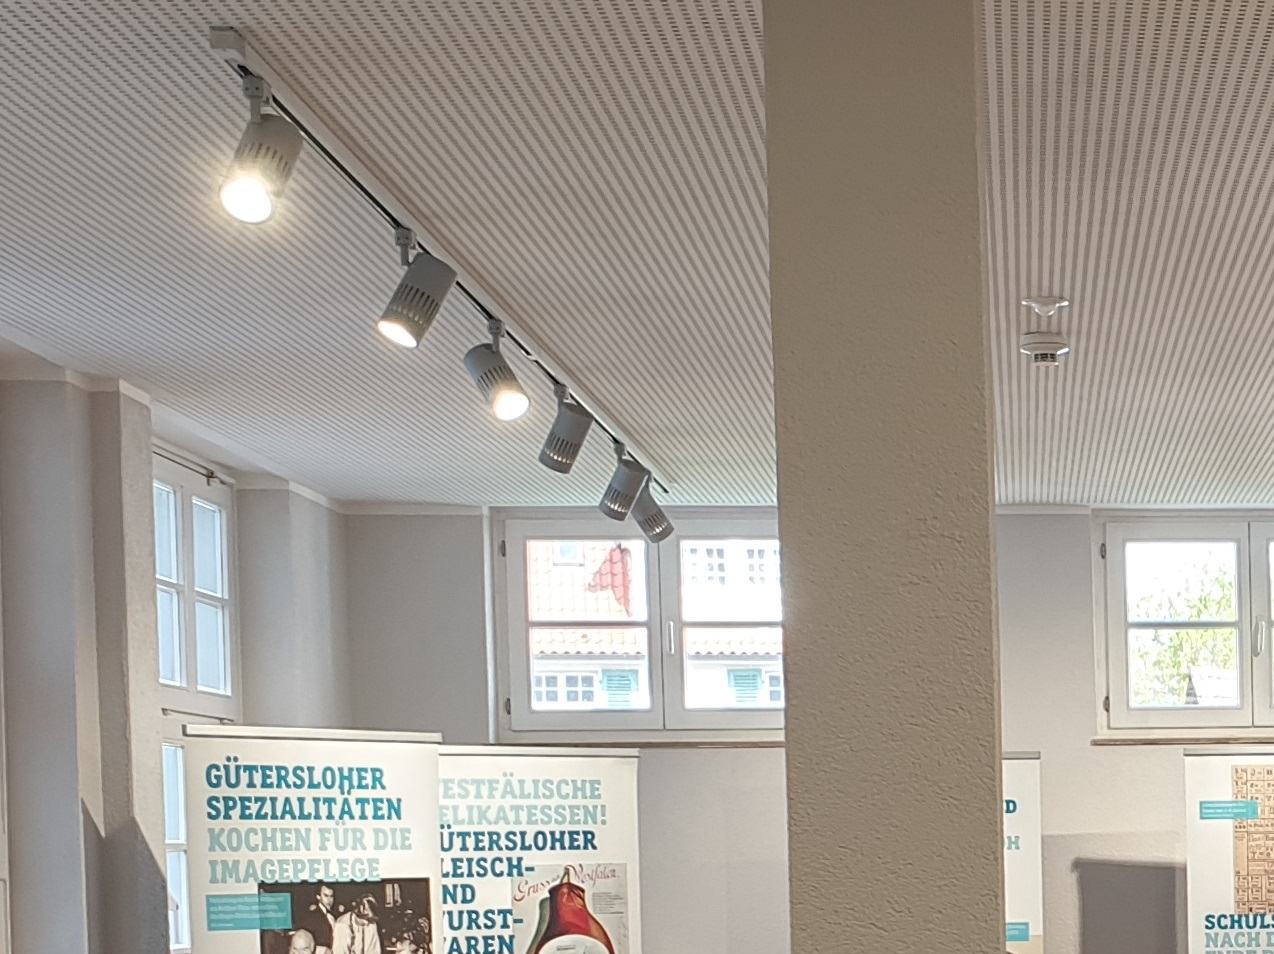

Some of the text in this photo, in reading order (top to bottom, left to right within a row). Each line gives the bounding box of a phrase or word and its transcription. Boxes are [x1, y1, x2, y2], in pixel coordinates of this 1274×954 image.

[206, 756, 386, 790] GÜTERSLOHER
[439, 772, 602, 800] ESTFÄLISCHE
[207, 789, 402, 820] SPEZIALITÄTEN
[208, 821, 411, 852] KOCHEN FÜR DIE
[209, 858, 381, 884] IMAGEPFLEGE
[443, 909, 523, 930] URST-
[1205, 932, 1260, 948] NACH
